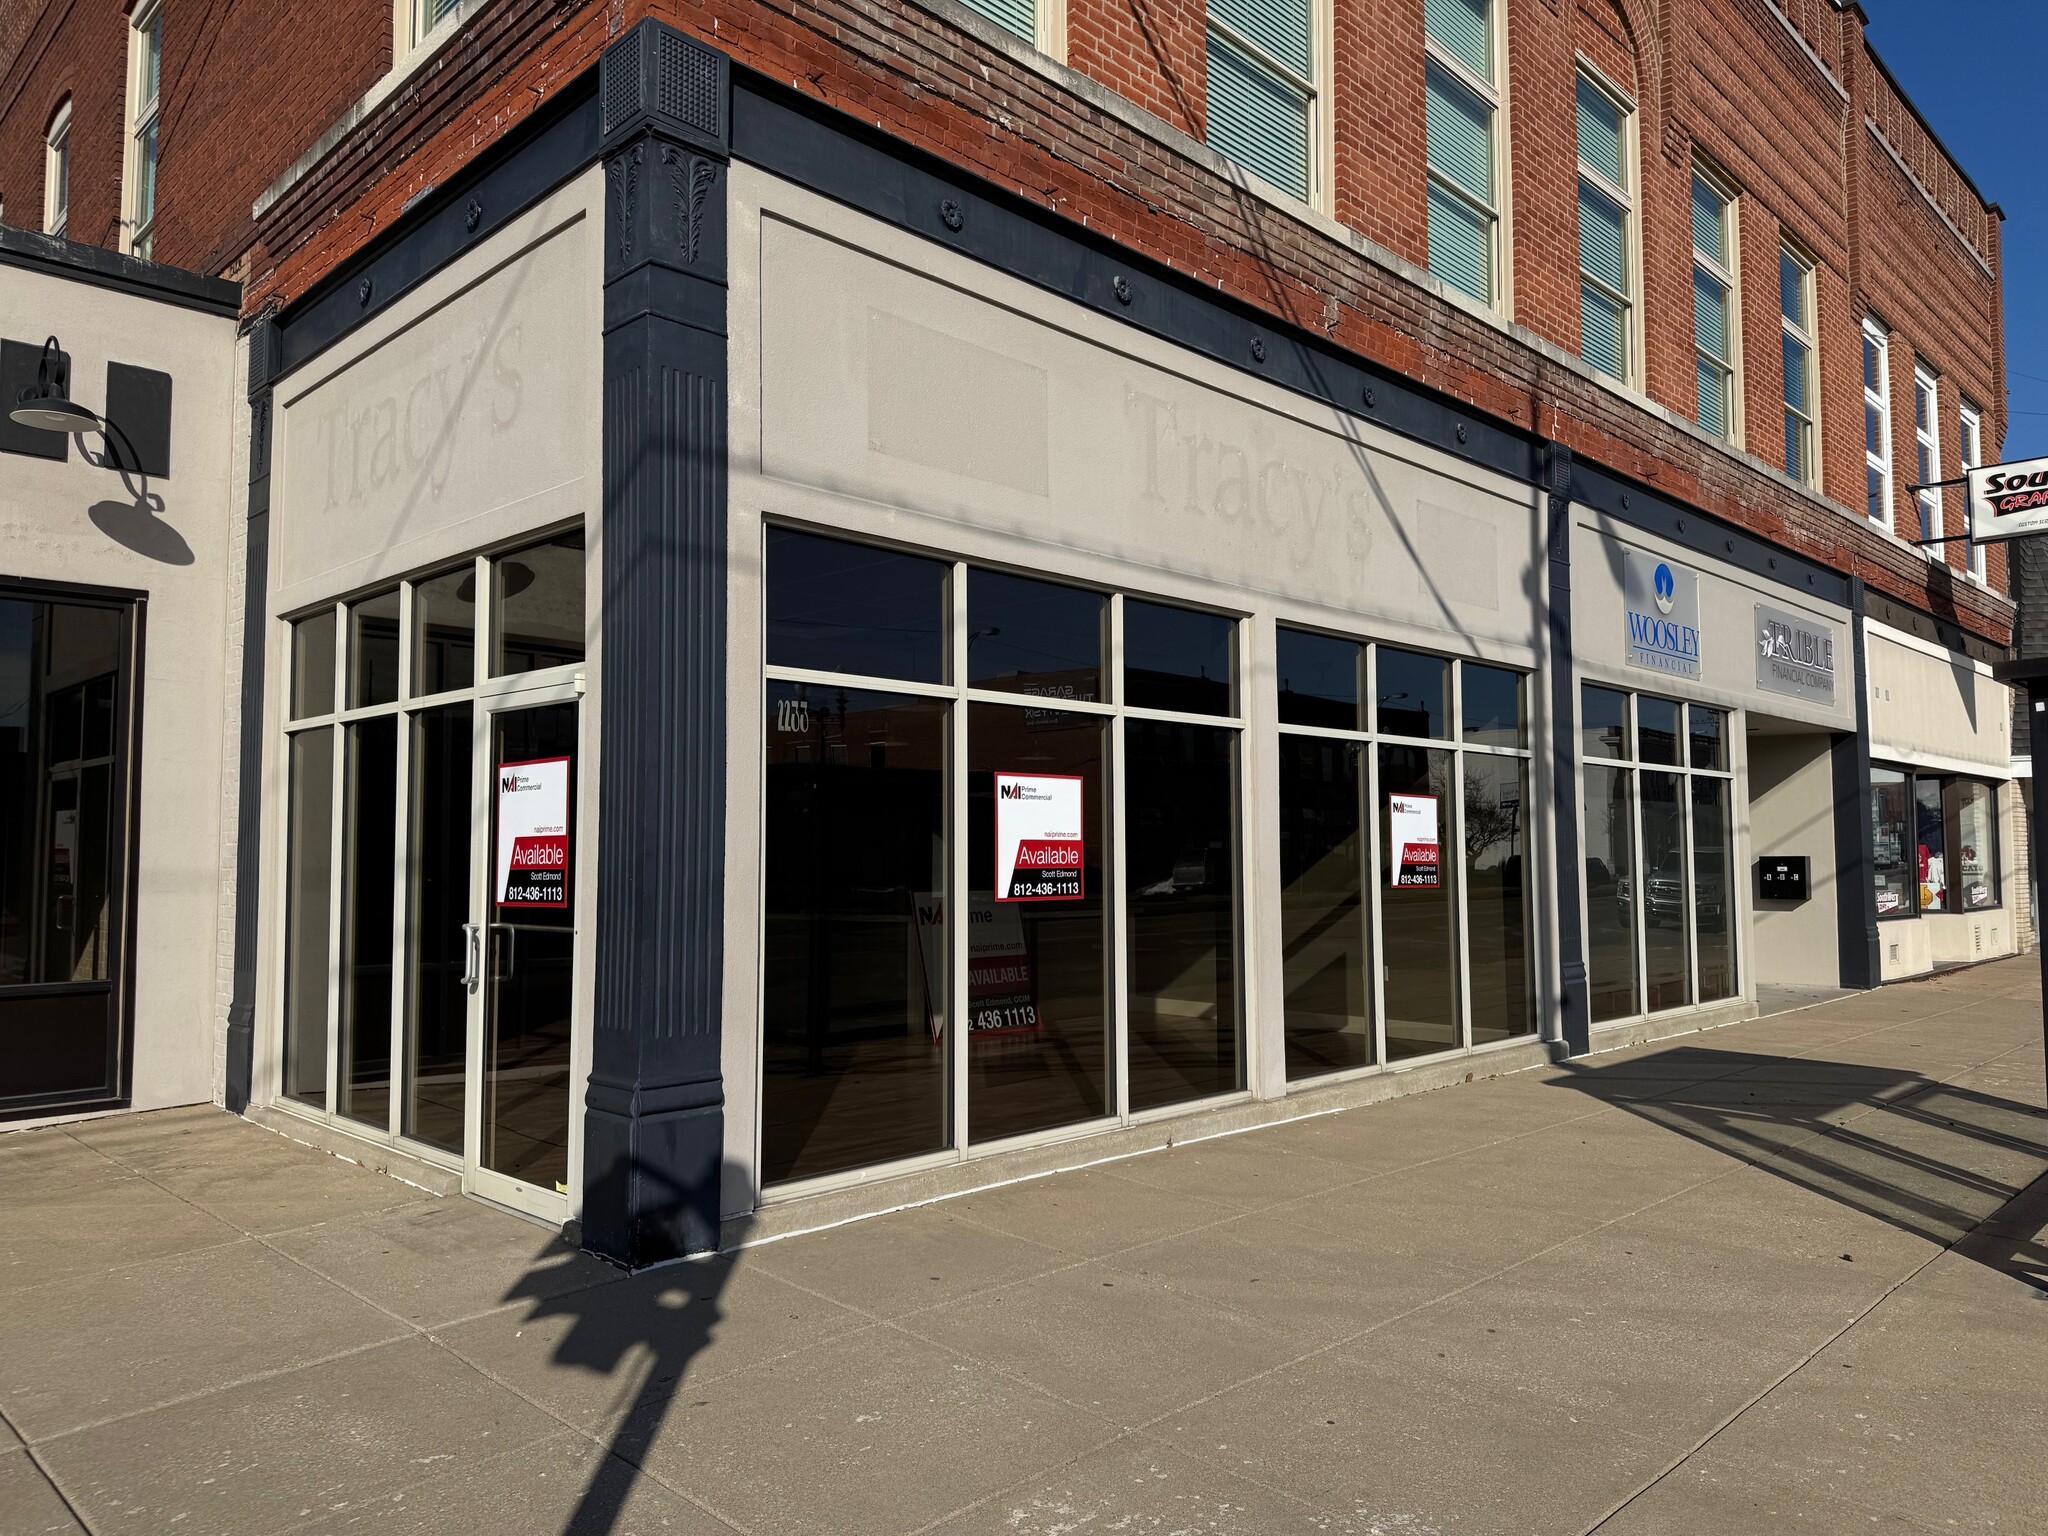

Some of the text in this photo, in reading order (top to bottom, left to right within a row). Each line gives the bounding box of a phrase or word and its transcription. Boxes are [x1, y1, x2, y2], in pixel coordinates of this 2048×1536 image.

[1627, 611, 1700, 657] WOOSLEY
[1639, 652, 1693, 675] FINANCIAL
[1772, 664, 1834, 693] FINANCIAL COMPANY
[501, 773, 517, 794] NAI
[517, 783, 542, 792] Commercial
[1001, 782, 1037, 800] NAI Prime
[1021, 793, 1052, 801] Commercial
[1393, 801, 1404, 814] NAI
[534, 825, 563, 834] naiprime.com
[1044, 831, 1078, 839] naiprime.com
[513, 844, 563, 865] Available
[1019, 846, 1078, 865] Available
[1403, 848, 1437, 862] Available
[531, 872, 562, 881] Scott Edmond
[1042, 870, 1077, 878] Scott Edmond
[1400, 874, 1437, 884] 812-436-1113
[508, 886, 563, 901] 812-436-1113
[1014, 882, 1079, 896] 812-436-1113
[918, 901, 943, 926] NA
[970, 942, 1023, 954] naiprime.com
[968, 966, 1029, 986] AVAILABLE
[968, 999, 985, 1009] Scott
[977, 1009, 1002, 1030] 436
[1004, 1006, 1036, 1027] 1113
